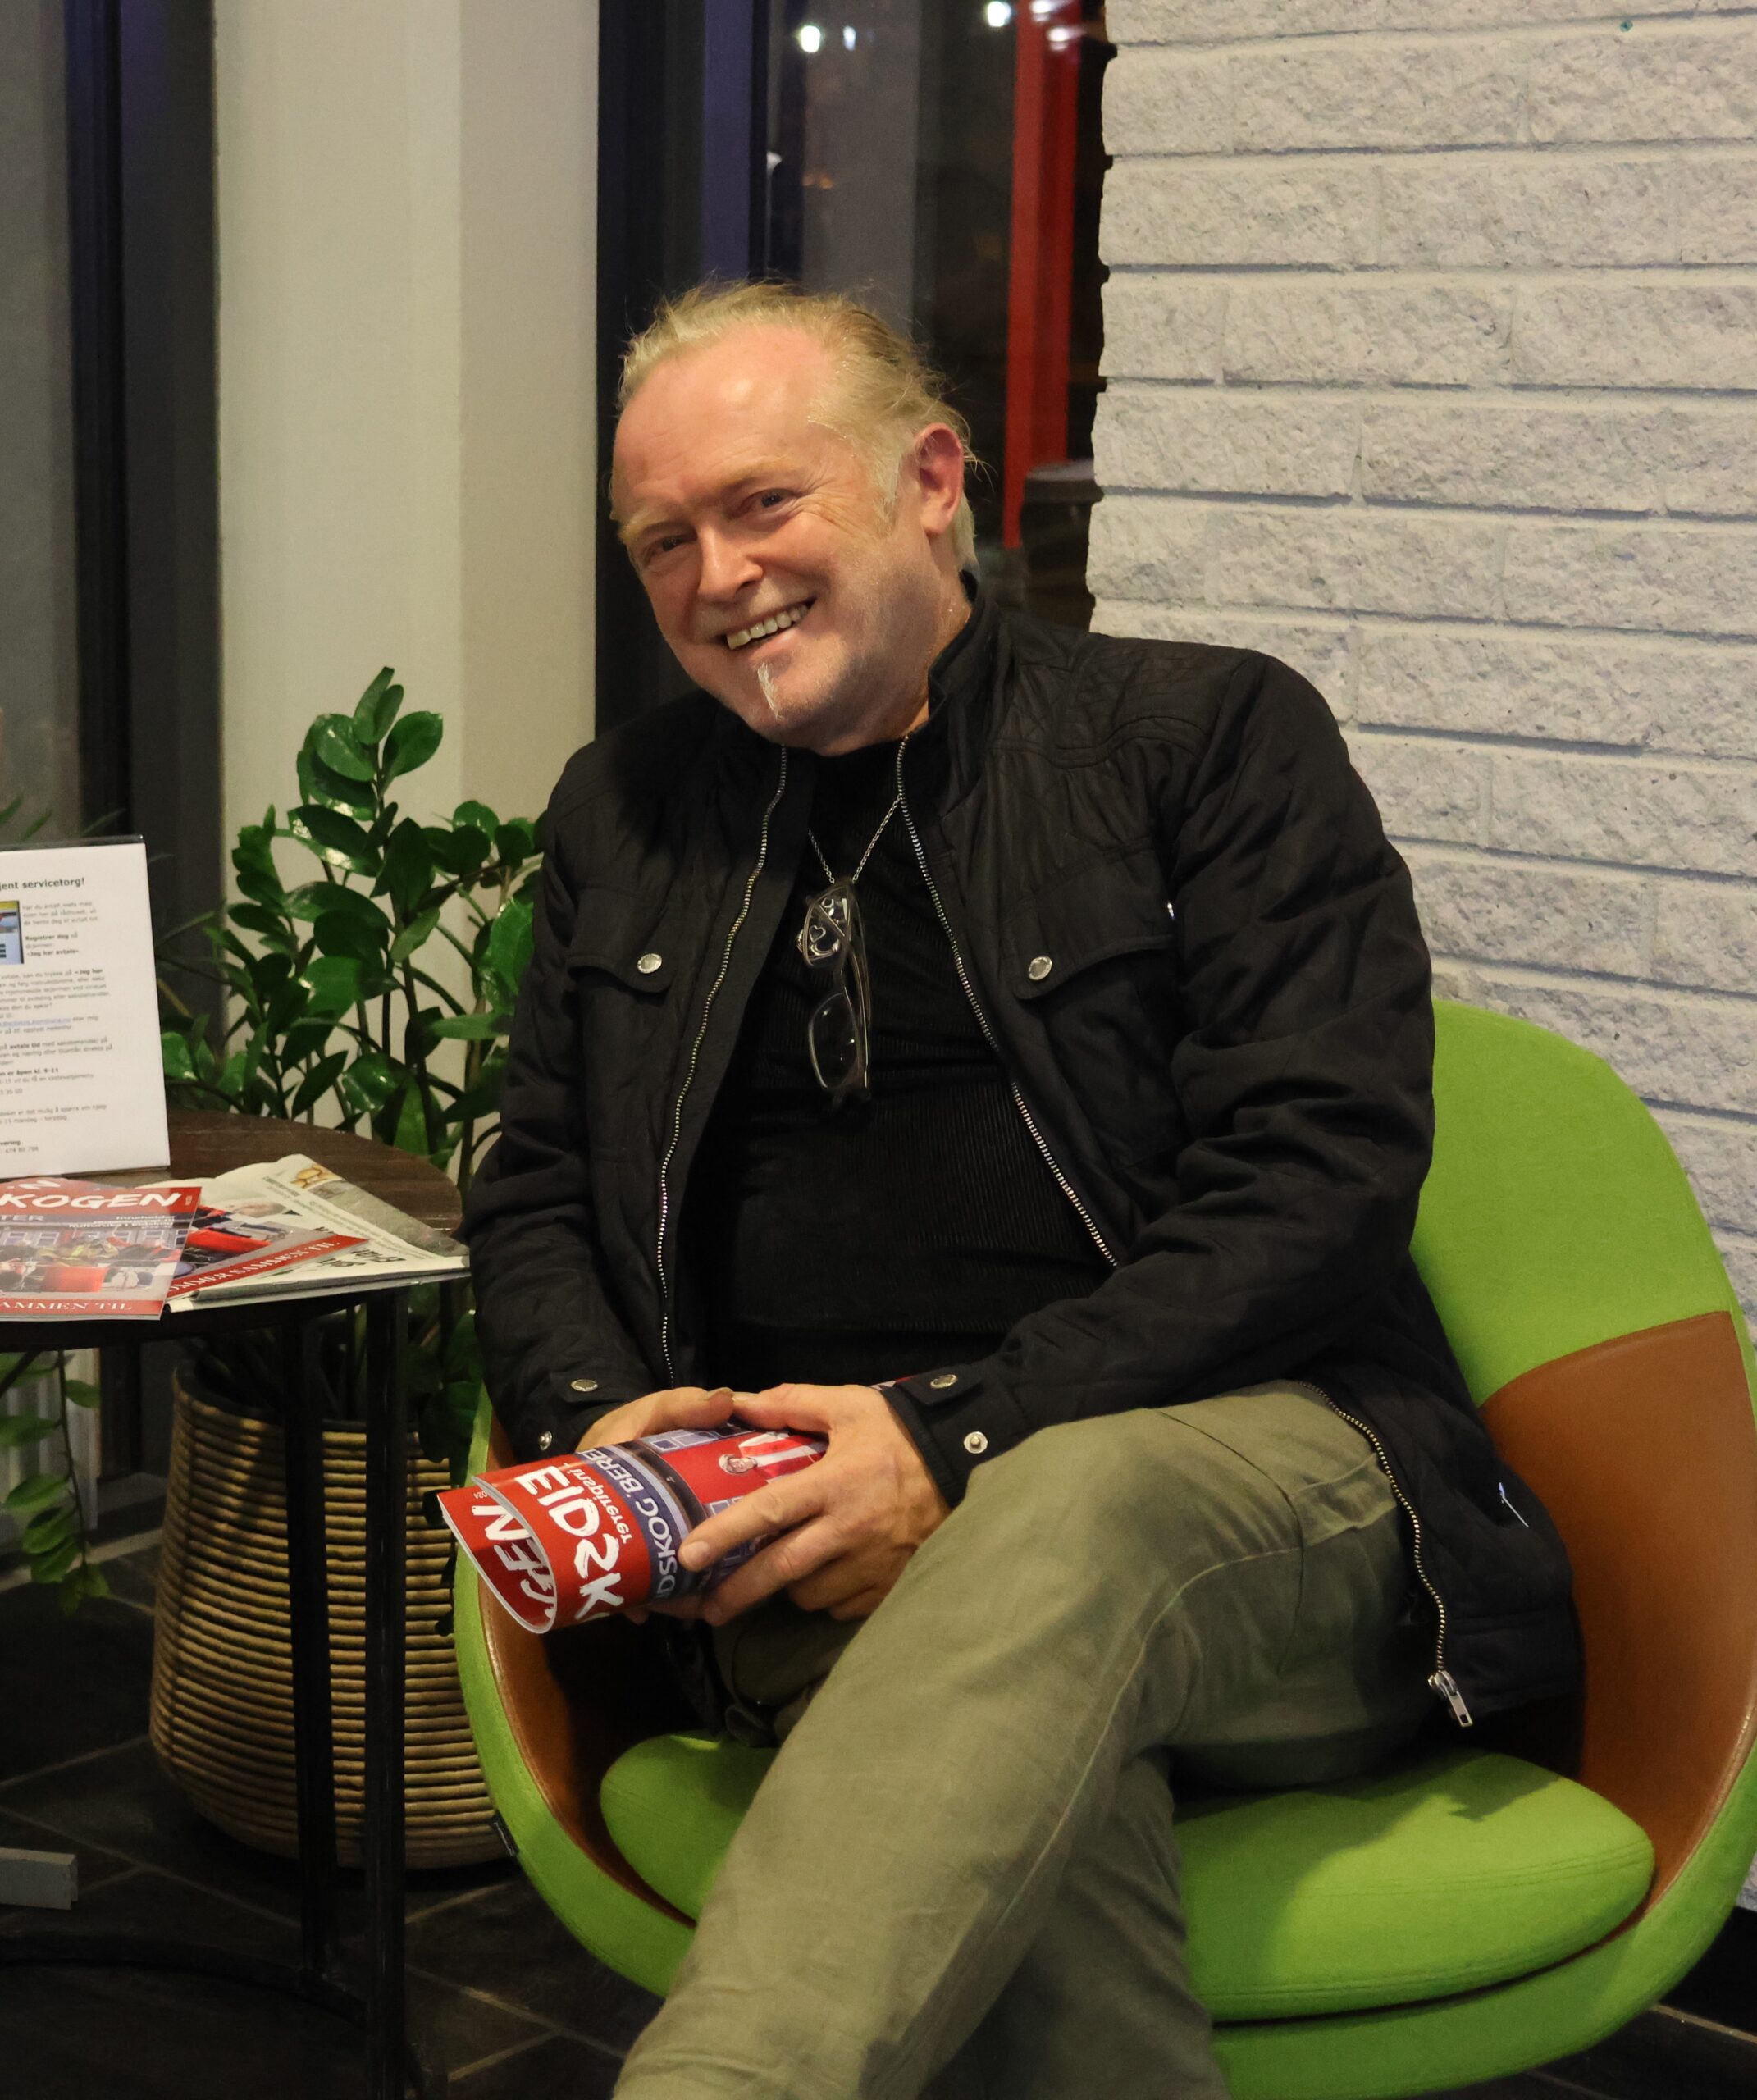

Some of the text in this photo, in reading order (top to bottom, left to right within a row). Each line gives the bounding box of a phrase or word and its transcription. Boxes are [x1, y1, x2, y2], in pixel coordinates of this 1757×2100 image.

[22, 877, 85, 888] servicetorg!
[0, 1192, 182, 1209] KOGEN
[472, 1505, 557, 1619] GEN
[635, 1497, 678, 1599] DSKOG
